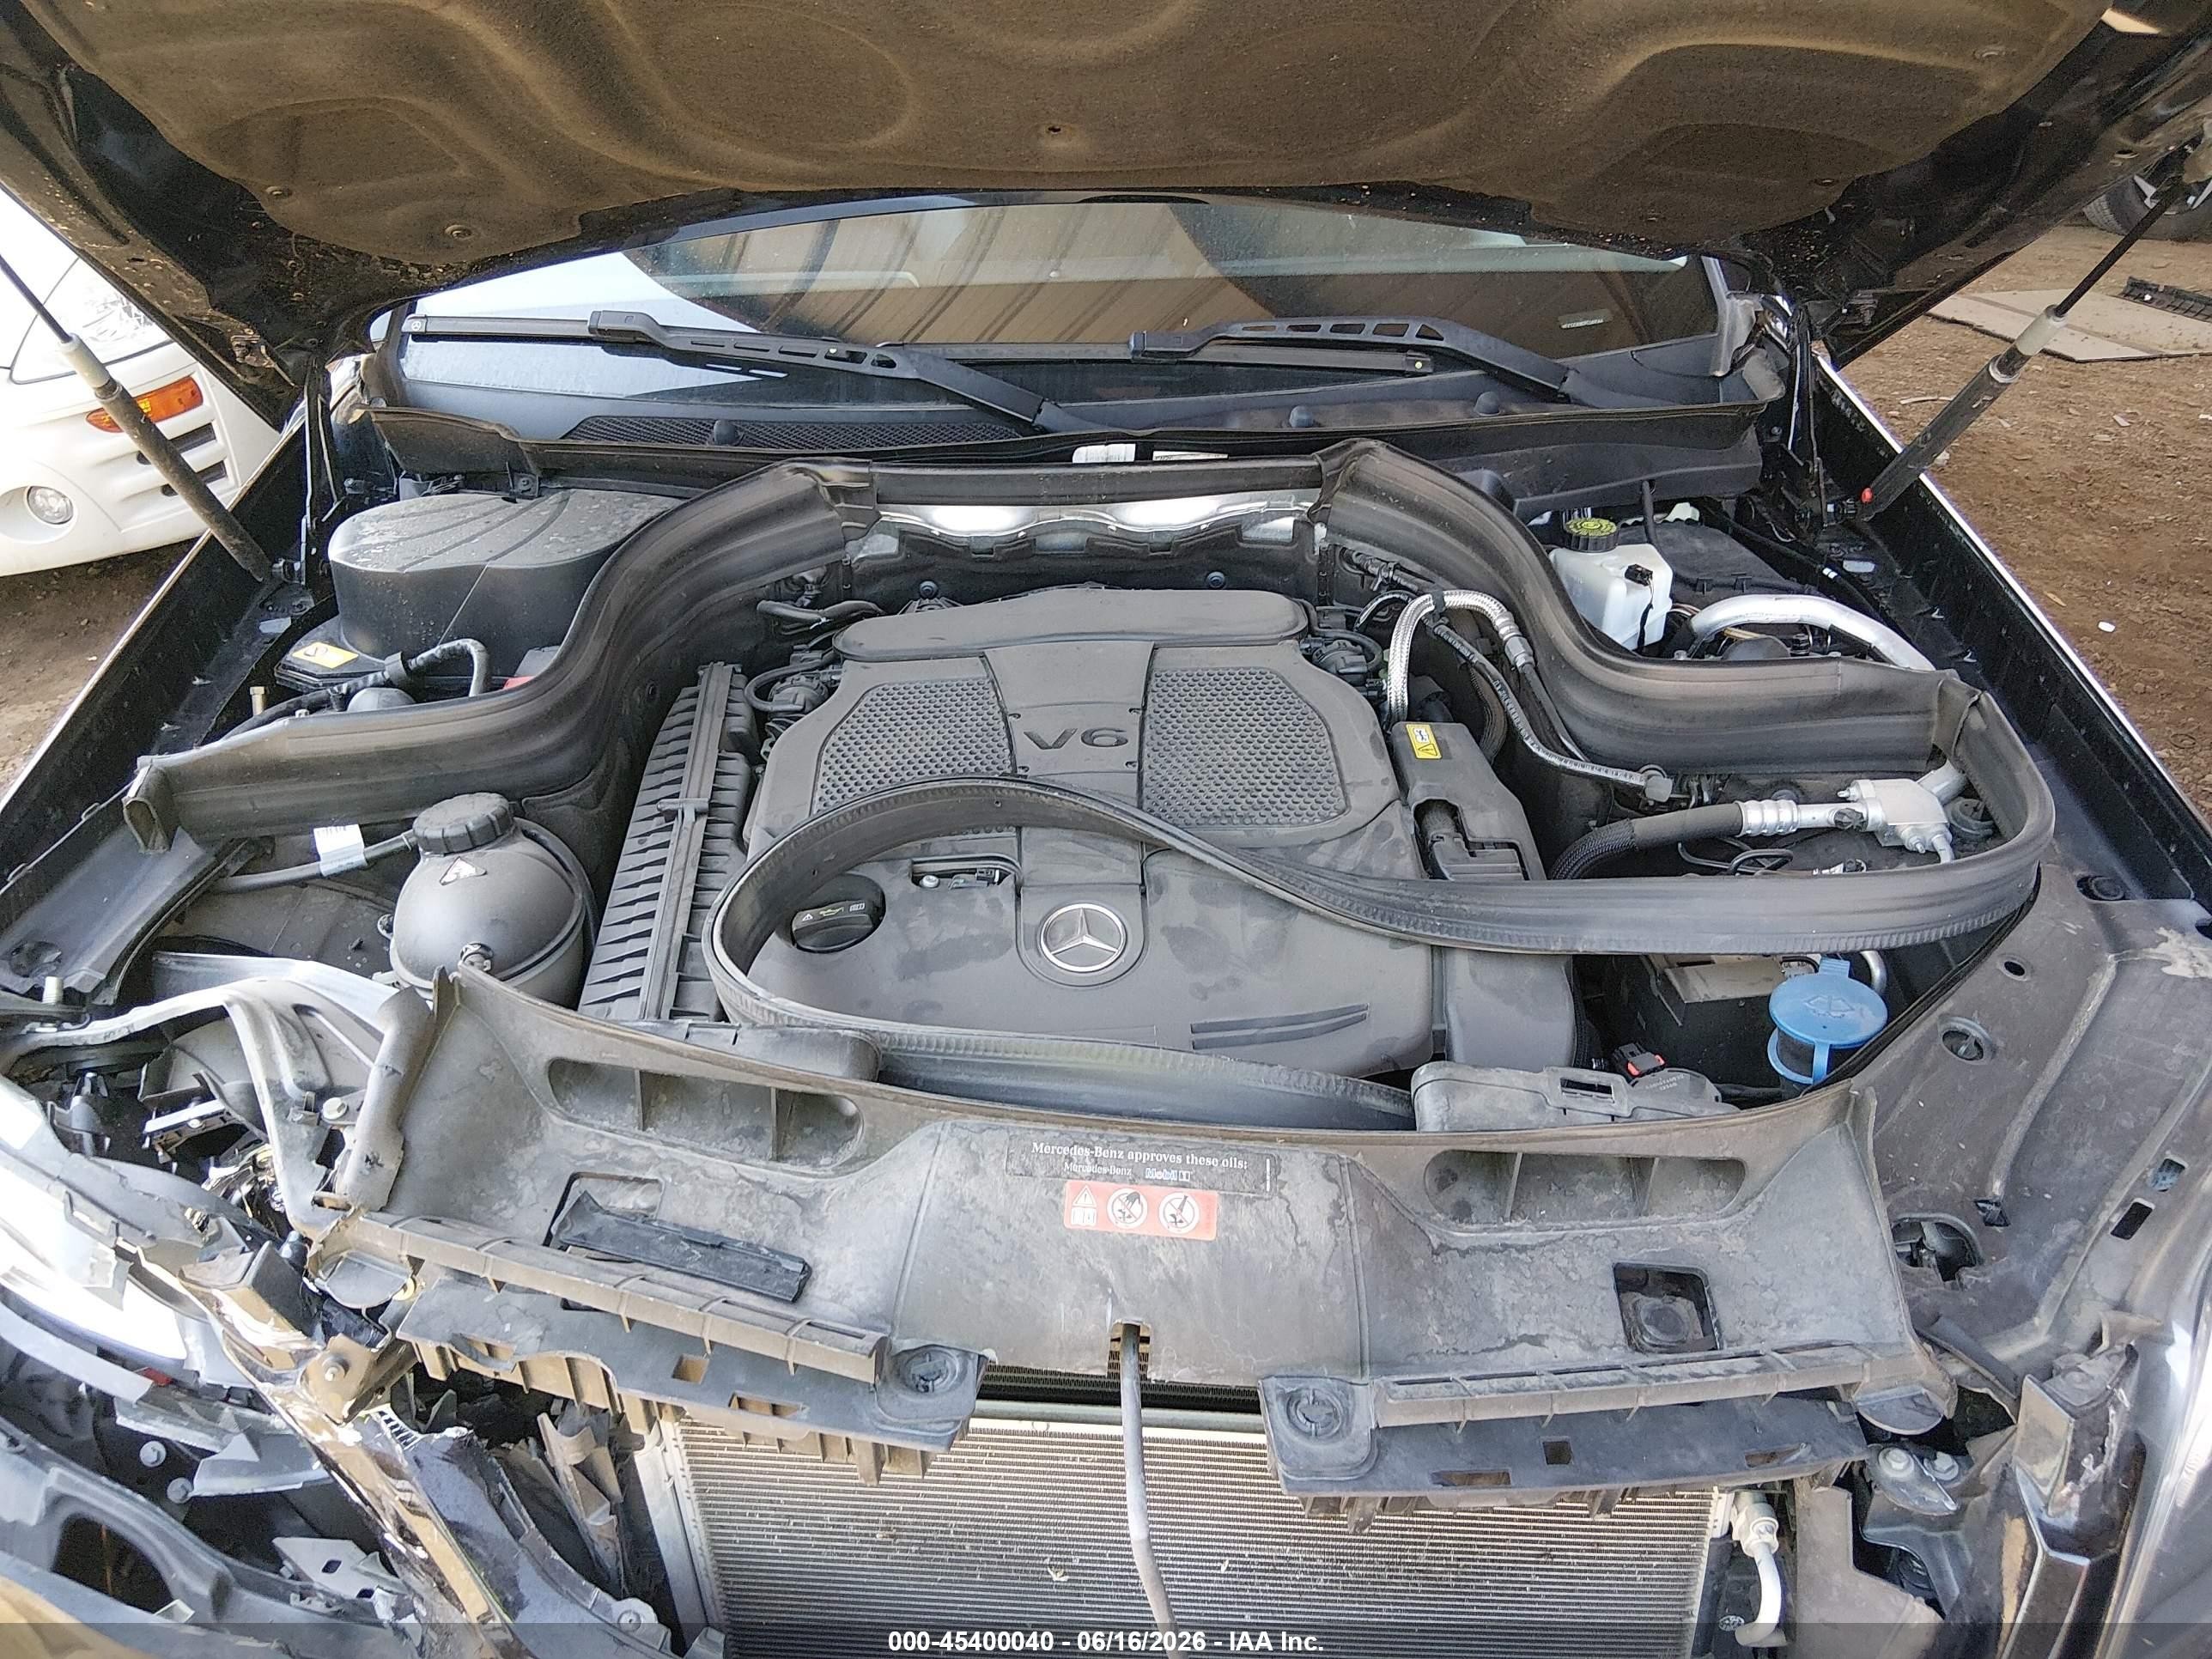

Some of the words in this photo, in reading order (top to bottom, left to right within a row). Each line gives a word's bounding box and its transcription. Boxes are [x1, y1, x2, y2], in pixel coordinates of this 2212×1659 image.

[1023, 727, 1129, 750] V6
[1031, 1142, 1125, 1159] Mercedes-Benz
[1127, 1151, 1182, 1164] approves
[1186, 1153, 1219, 1167] these
[1221, 1157, 1248, 1170] oils:
[1064, 1162, 1133, 1176] Mercedes-Benz
